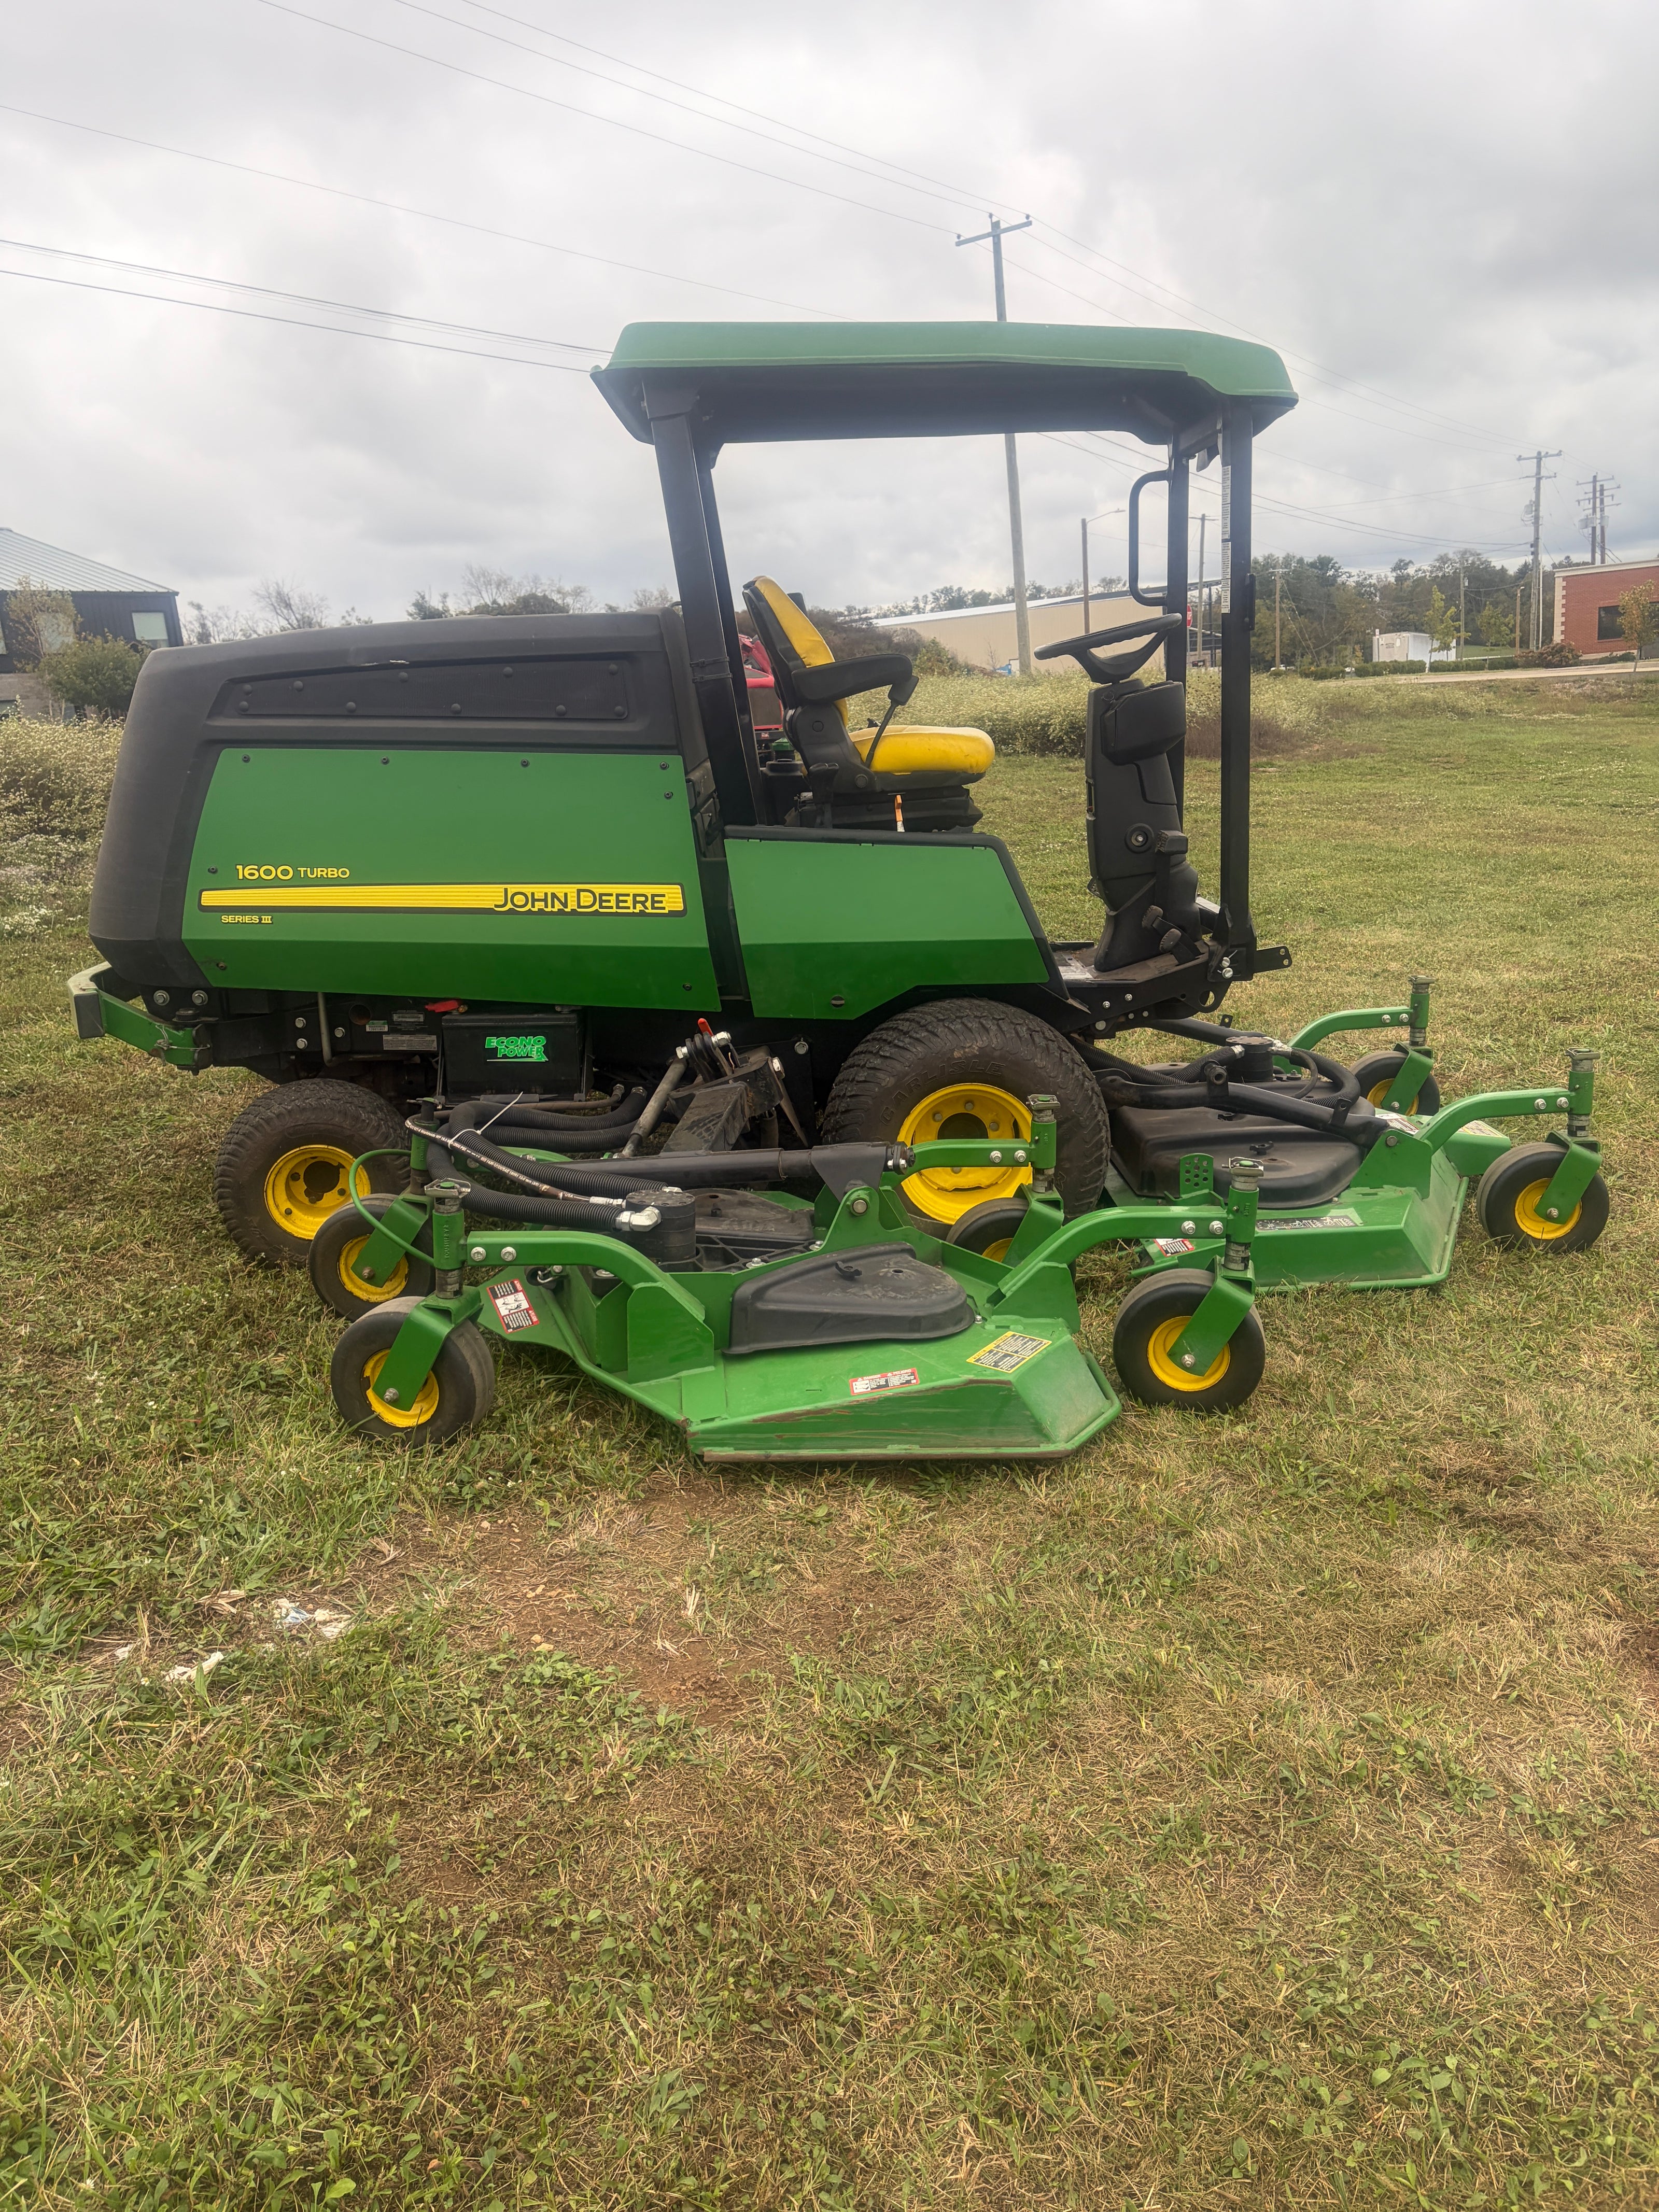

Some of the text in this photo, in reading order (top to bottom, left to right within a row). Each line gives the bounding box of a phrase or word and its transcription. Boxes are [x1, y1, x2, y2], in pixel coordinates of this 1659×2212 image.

[236, 865, 350, 880] 1600 TURBO
[494, 887, 667, 911] JOHN DEERE
[221, 915, 259, 923] SERIES
[485, 1036, 546, 1048] ECONO
[497, 1046, 547, 1059] POWER
[879, 1060, 1006, 1126] CARLISLE
